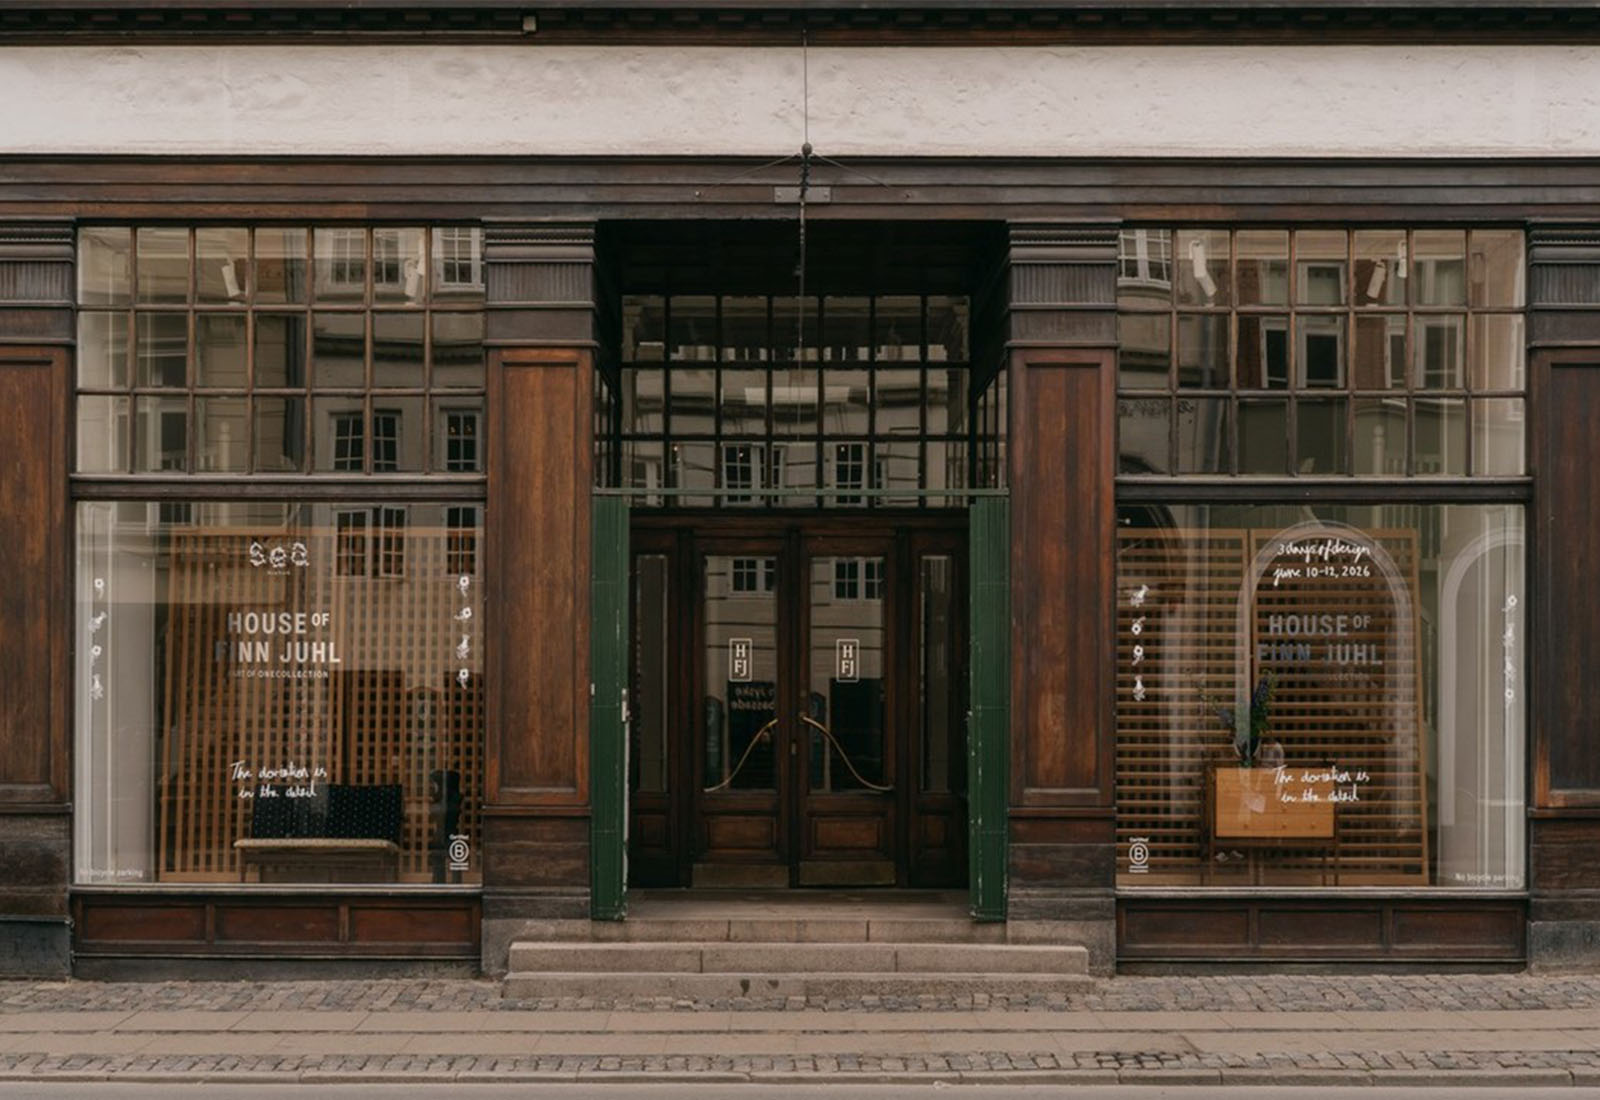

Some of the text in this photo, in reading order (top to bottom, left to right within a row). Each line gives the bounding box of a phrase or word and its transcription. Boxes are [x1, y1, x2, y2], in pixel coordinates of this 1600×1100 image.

[1306, 565, 1339, 579] 10-12,
[1341, 565, 1371, 578] 2026
[227, 612, 330, 634] HOUSE OF
[1268, 614, 1371, 636] HOUSE OF
[280, 641, 341, 663] JUHL
[1256, 643, 1383, 665] FINN JUHL
[230, 760, 253, 780] The
[1272, 763, 1294, 785] The
[260, 783, 280, 798] the
[1302, 787, 1320, 803] the
